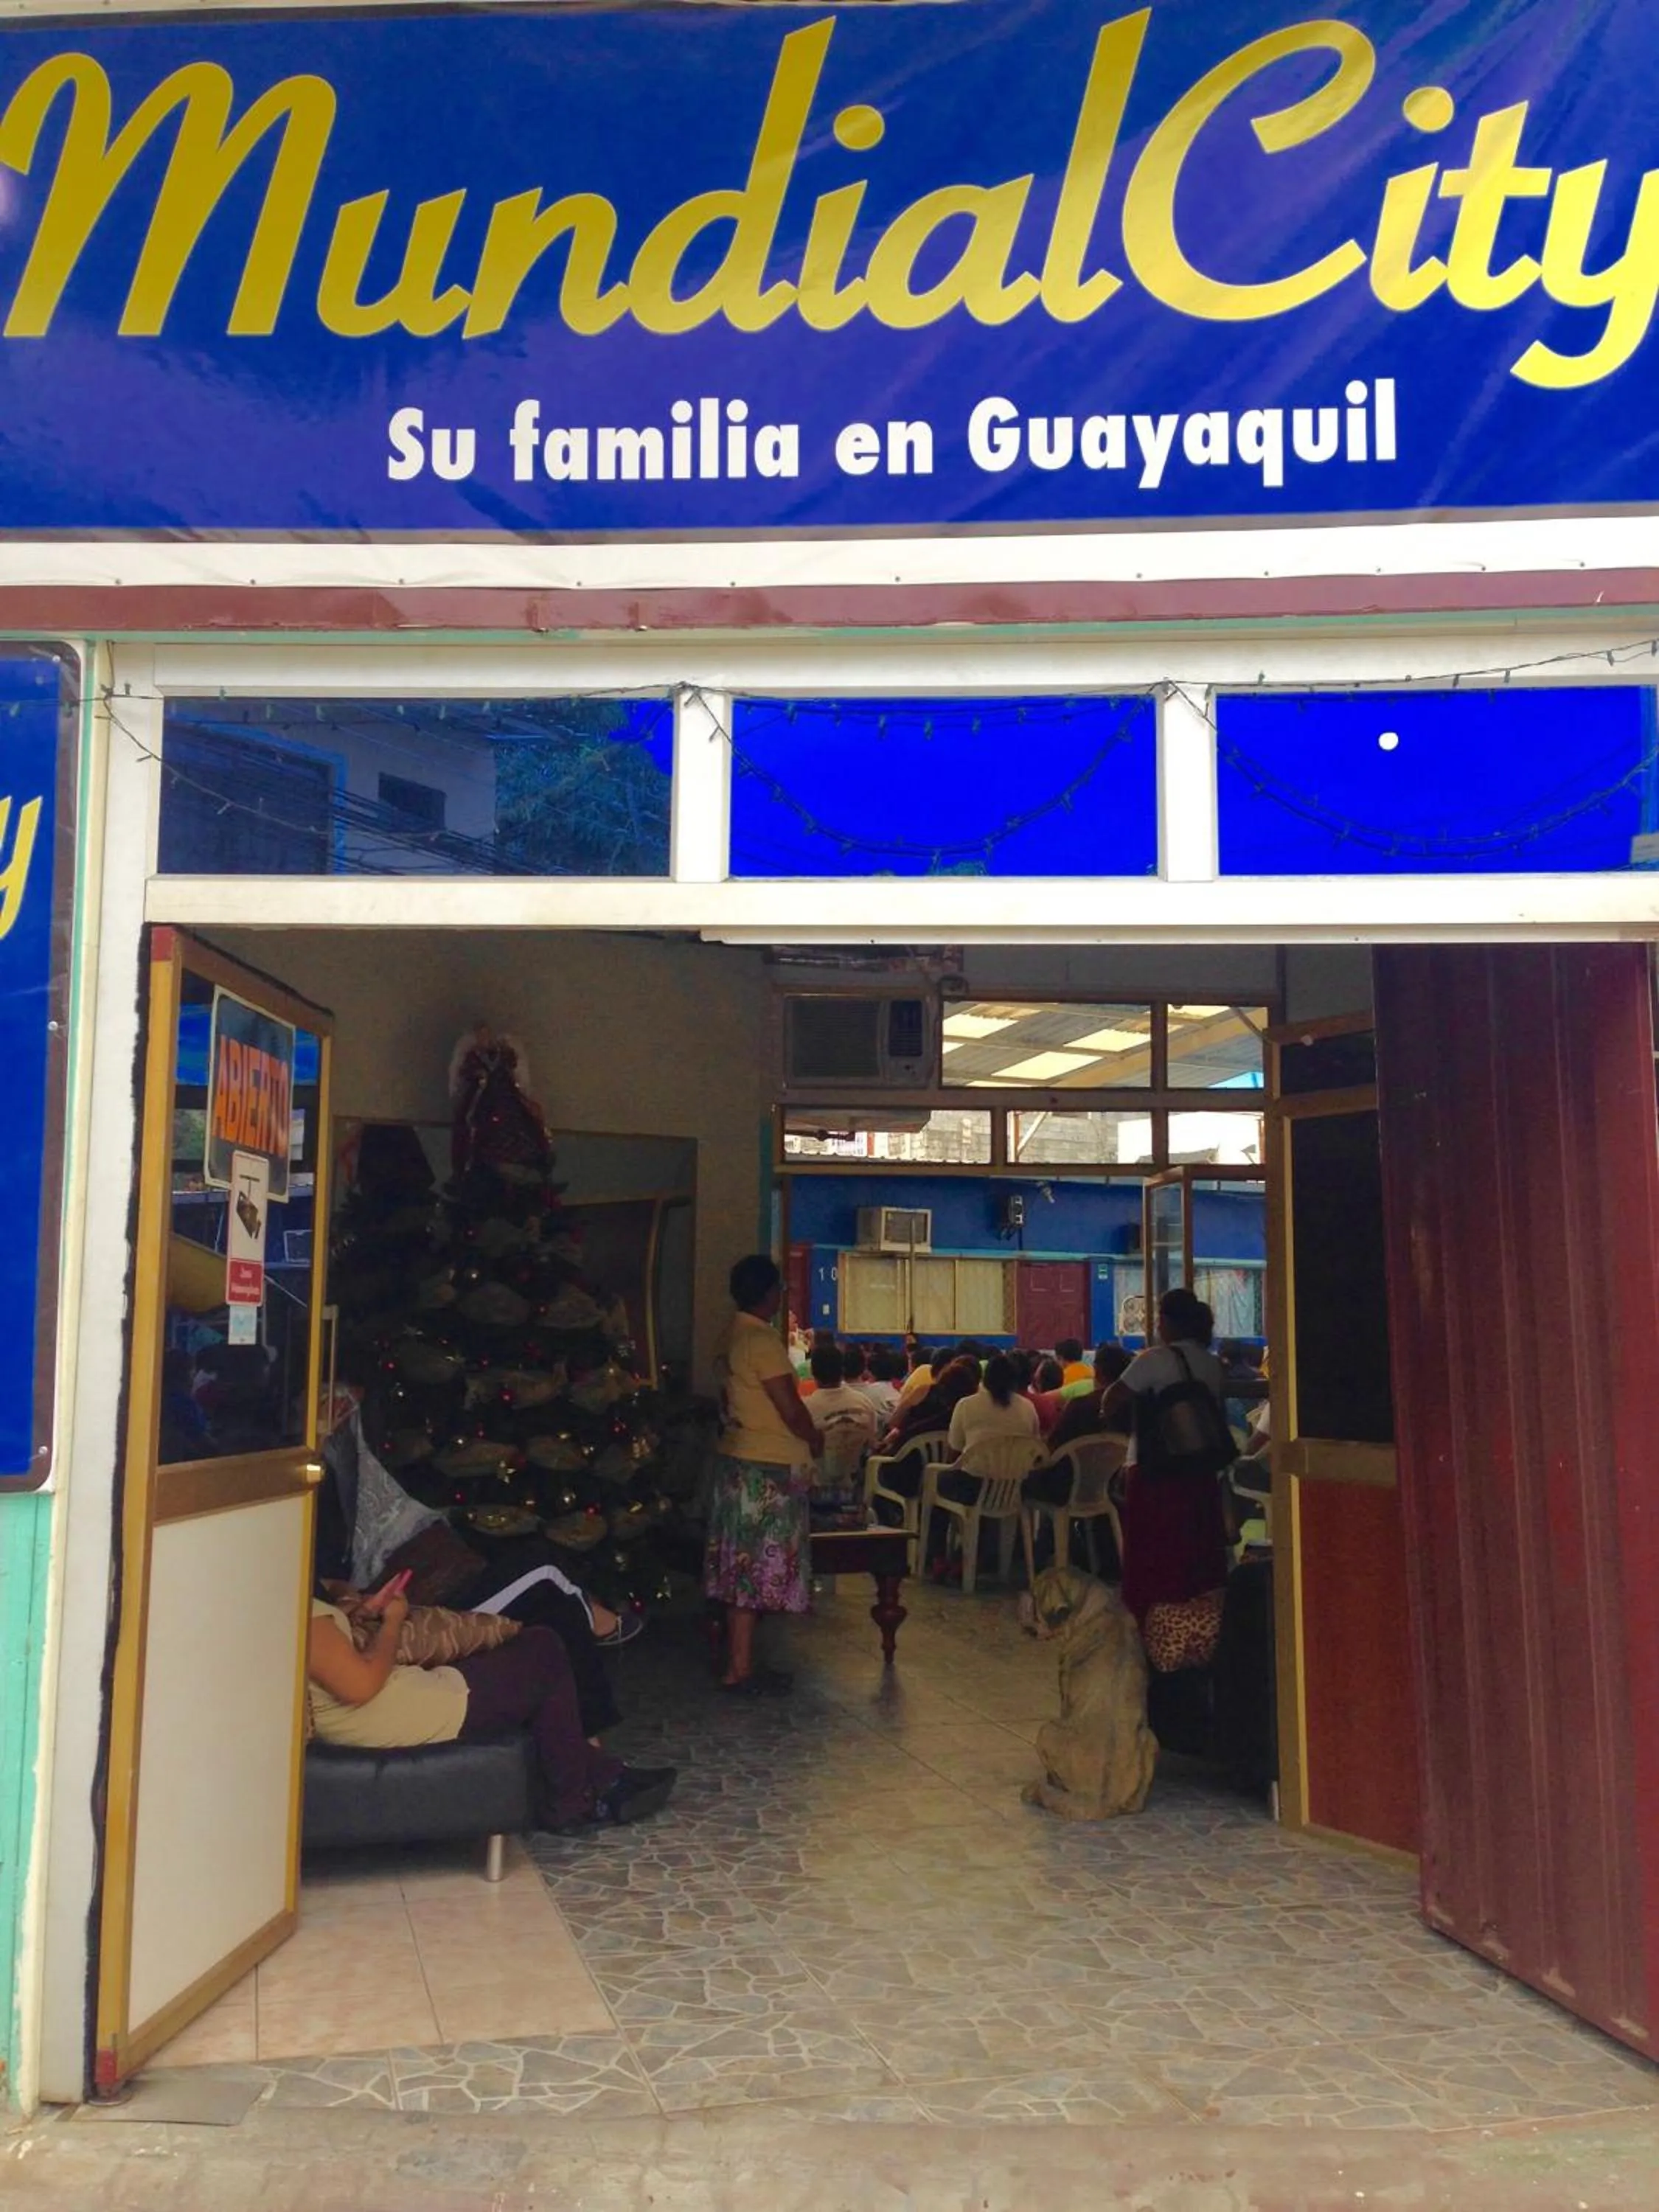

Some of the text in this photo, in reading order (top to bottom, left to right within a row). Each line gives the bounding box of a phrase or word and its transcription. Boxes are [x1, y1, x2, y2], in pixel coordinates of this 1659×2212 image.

[389, 378, 1397, 489] Su familia en Guayaquil
[212, 1034, 289, 1158] ABIERTO
